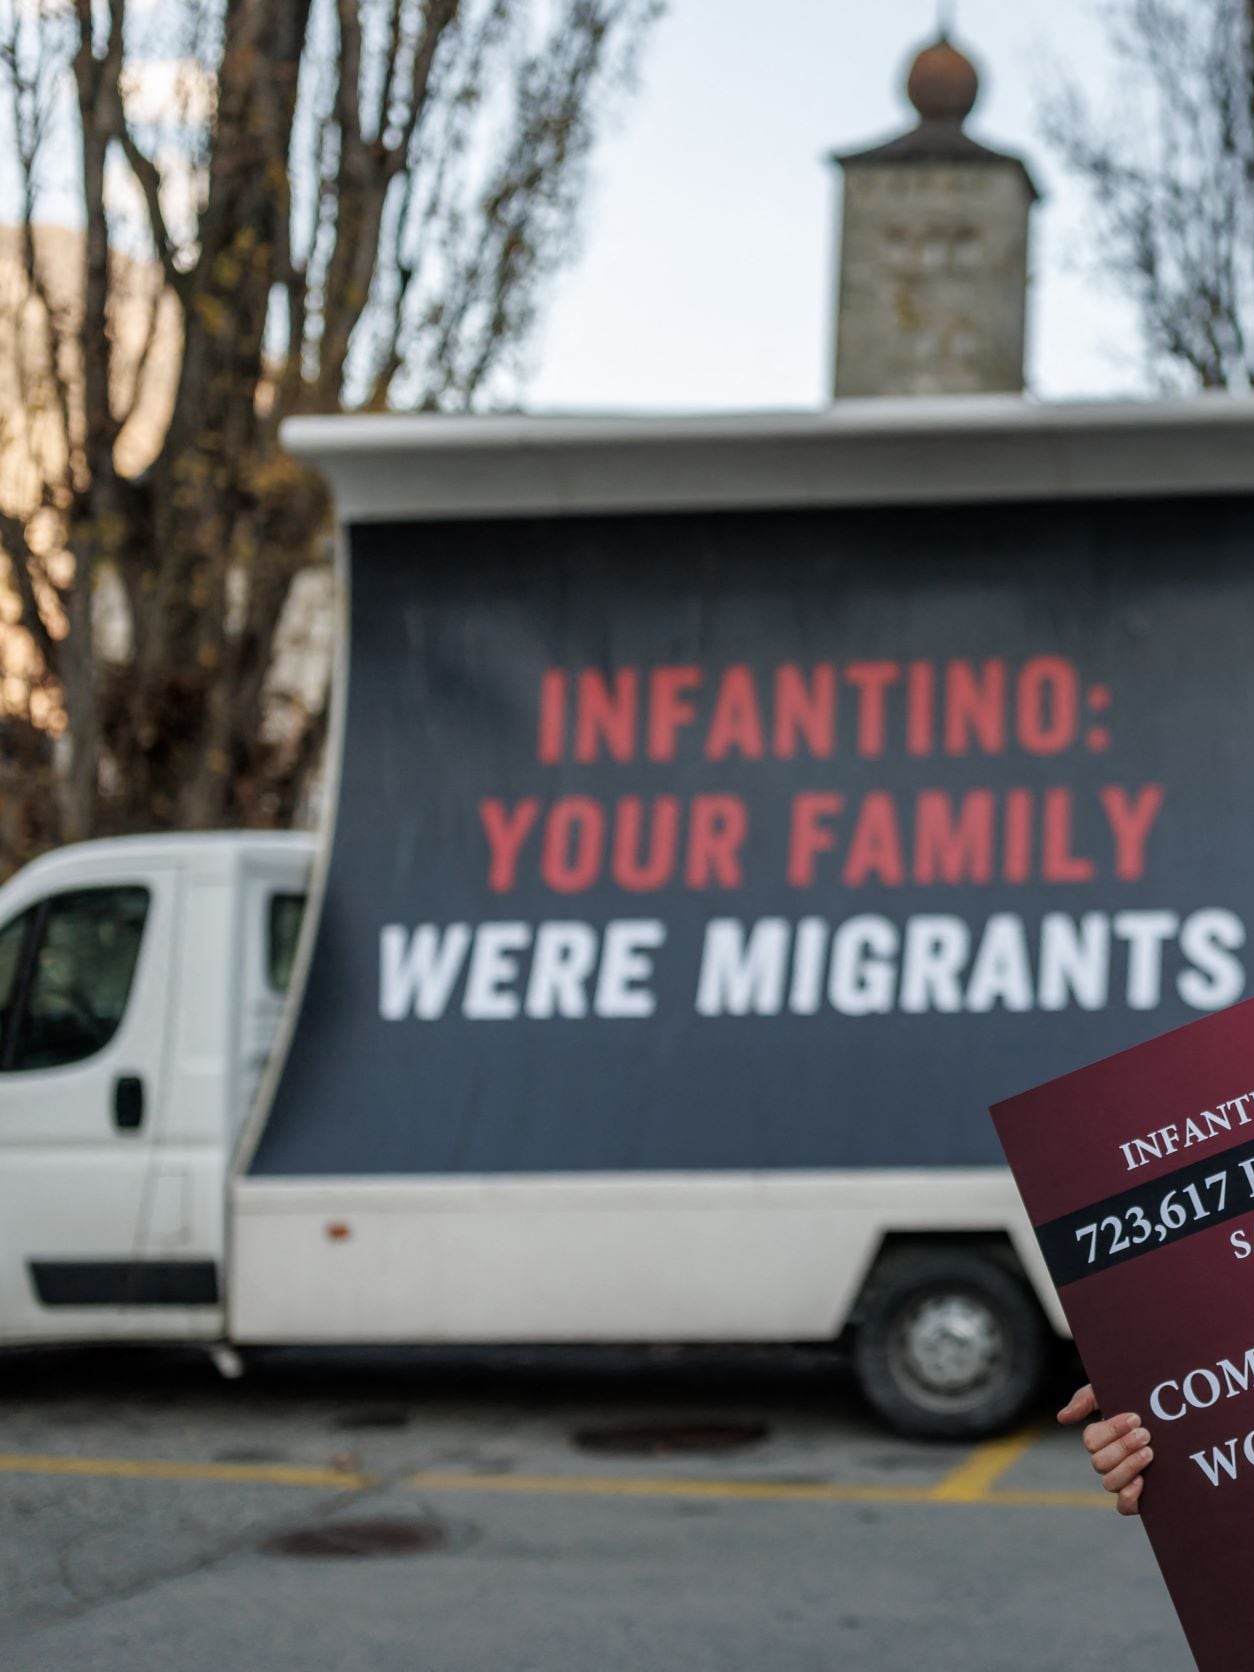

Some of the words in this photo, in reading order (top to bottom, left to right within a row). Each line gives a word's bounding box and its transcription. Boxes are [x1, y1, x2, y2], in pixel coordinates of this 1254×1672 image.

[537, 655, 1110, 766] INFANTINO:
[480, 796, 748, 894] YOUR
[787, 785, 1164, 888] FAMILY
[378, 921, 666, 1021] WERE
[696, 908, 1246, 1017] MIGRANTS
[1074, 1170, 1228, 1265] 723,617
